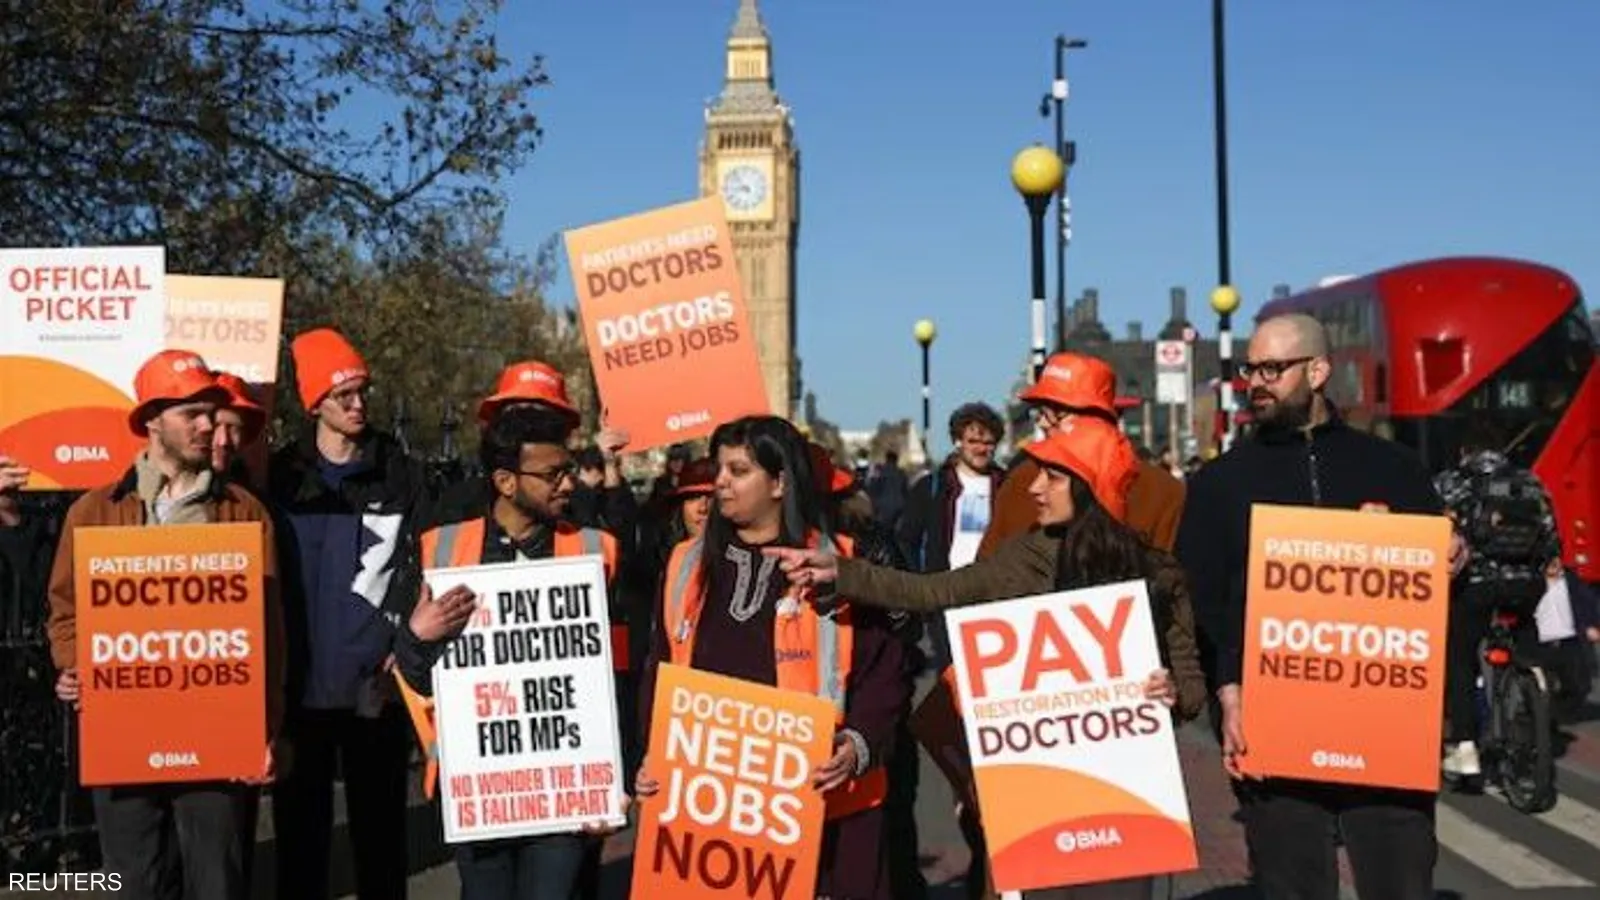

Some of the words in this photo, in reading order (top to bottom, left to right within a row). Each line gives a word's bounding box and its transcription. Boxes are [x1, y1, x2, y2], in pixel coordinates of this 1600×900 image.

[9, 265, 152, 293] OFFICIAL
[587, 244, 722, 298] DOCTORS
[26, 295, 136, 321] PICKET
[596, 291, 734, 346] DOCTORS
[165, 315, 268, 343] OCTORS
[604, 338, 672, 371] NEED
[680, 322, 739, 358] JOBS
[73, 446, 110, 461] BMA
[89, 554, 187, 575] PATIENTS
[191, 552, 248, 572] NEED
[1264, 537, 1368, 562] PATIENTS
[1373, 546, 1435, 567] NEED
[91, 573, 248, 607] DOCTORS
[1263, 560, 1433, 602] DOCTORS
[497, 588, 540, 625] PAY
[548, 583, 592, 620] CUT
[91, 628, 251, 664] DOCTORS
[493, 622, 601, 665] DOCTORS
[958, 595, 1136, 698] PAY
[1259, 616, 1430, 661] DOCTORS
[93, 665, 173, 690] NEED
[180, 662, 251, 691] JOBS
[1259, 654, 1344, 683] NEED
[1350, 661, 1428, 690] JOBS
[474, 681, 518, 718] 5%
[522, 675, 576, 713] RISE
[671, 686, 814, 743] DOCTORS
[973, 685, 1110, 720] RESTORATION
[1114, 681, 1146, 702] FO
[477, 719, 522, 757] FOR
[529, 715, 581, 751] MPs
[977, 703, 1160, 757] DOCTORS
[165, 753, 200, 767] BMA
[665, 716, 810, 790] NEED
[1329, 755, 1365, 770] BMA
[450, 774, 473, 799] NO
[476, 767, 544, 795] WONDER
[548, 764, 577, 790] THE
[581, 761, 614, 786] NHS
[458, 801, 477, 828] IS
[482, 793, 551, 826] FALLING
[555, 789, 610, 818] APART
[658, 768, 803, 845] JOBS
[1077, 827, 1122, 848] BMA
[653, 826, 796, 900] NOW
